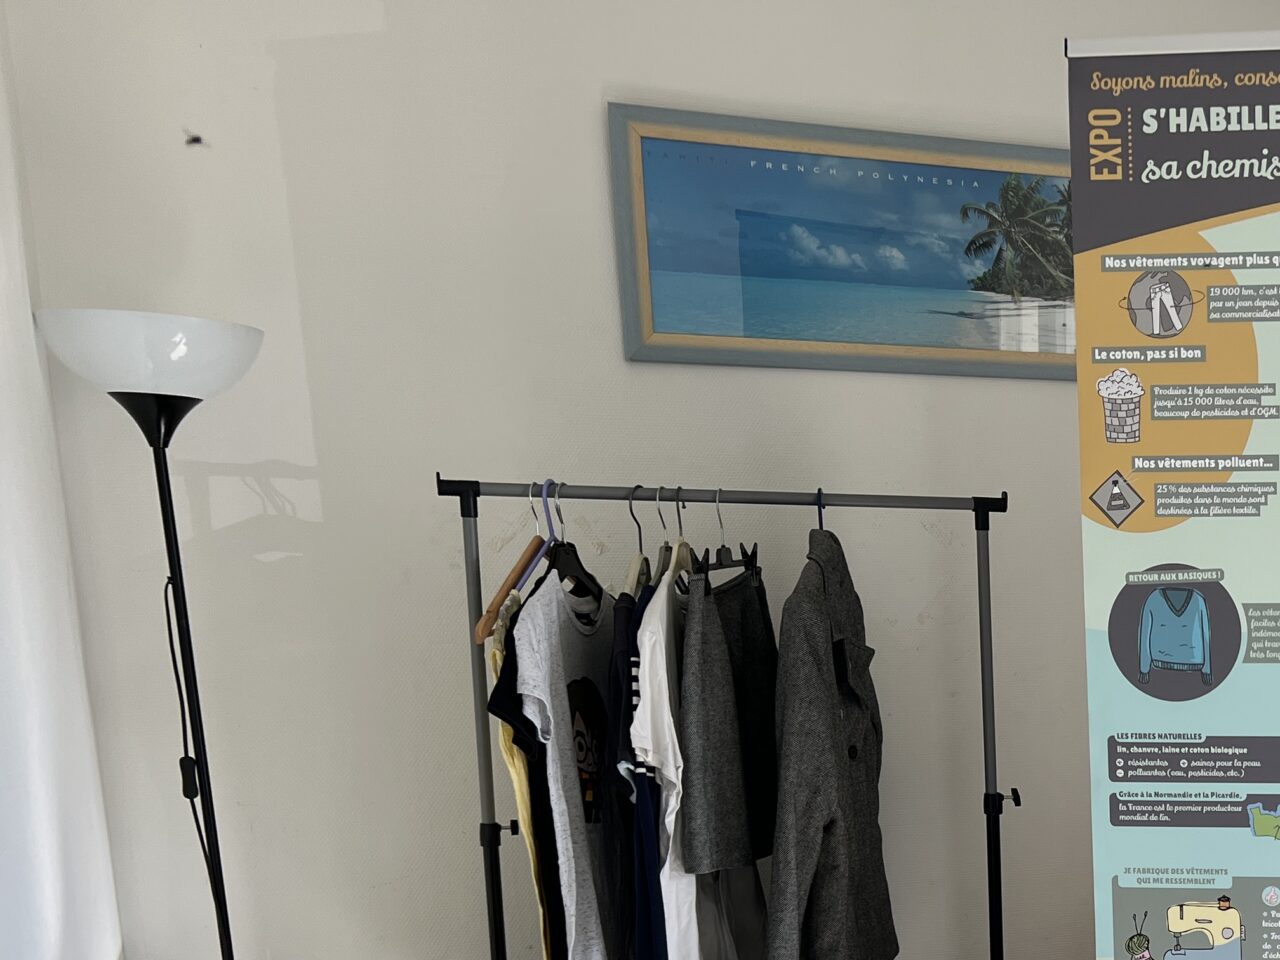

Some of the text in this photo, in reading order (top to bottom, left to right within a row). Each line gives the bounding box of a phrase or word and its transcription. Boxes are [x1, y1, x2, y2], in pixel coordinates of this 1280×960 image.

[1090, 72, 1156, 96] Soyons
[1159, 68, 1228, 93] malins,
[1088, 108, 1123, 182] EXPO
[750, 160, 981, 188] FRENCH POLYNESIA
[1141, 157, 1182, 183] sa
[1105, 256, 1127, 268] Nos
[1129, 255, 1188, 268] vêtements
[1246, 253, 1270, 266] plus
[1209, 286, 1220, 296] 19
[1222, 286, 1239, 296] 000
[1094, 348, 1201, 361] Le coton, pas si bon
[1134, 457, 1155, 469] Nos
[1158, 457, 1216, 469] vêtements
[1129, 572, 1158, 582] RETOUR
[1160, 572, 1176, 581] AUX
[1178, 571, 1216, 581] BASIQUES
[1117, 732, 1202, 740] LES FIBRES NATURELLES
[1132, 868, 1171, 876] FABRIQUE
[1171, 868, 1185, 876] DES
[1186, 866, 1228, 876] VÊTEMENTS
[1136, 877, 1216, 885] QUI ME RESSEMBLENT
